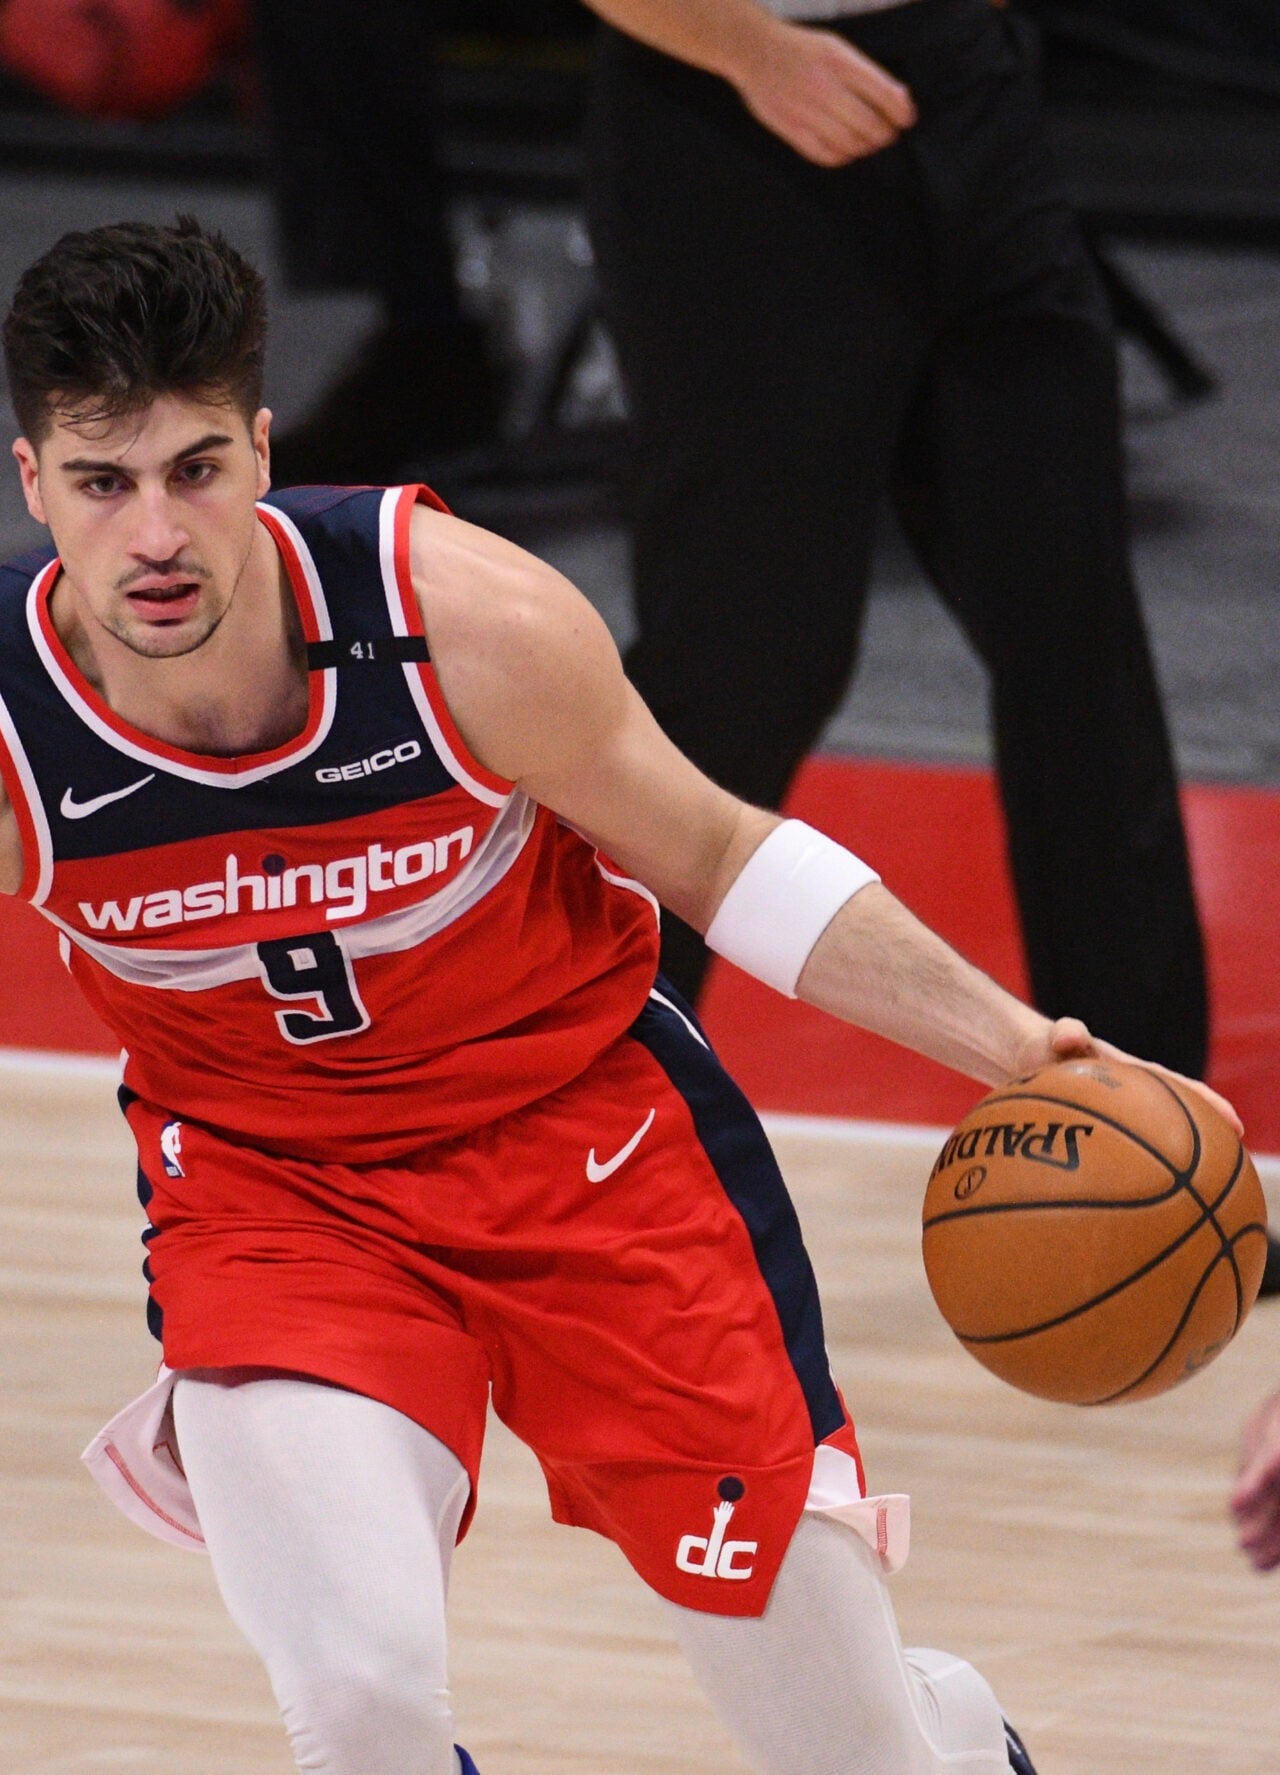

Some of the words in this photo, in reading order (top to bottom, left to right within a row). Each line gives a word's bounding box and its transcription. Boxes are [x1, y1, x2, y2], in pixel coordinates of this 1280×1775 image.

[350, 641, 375, 660] 41
[315, 740, 421, 783] GEICO
[78, 825, 474, 932] washington
[254, 929, 372, 1046] 9
[931, 1122, 1094, 1178] SPALDIN
